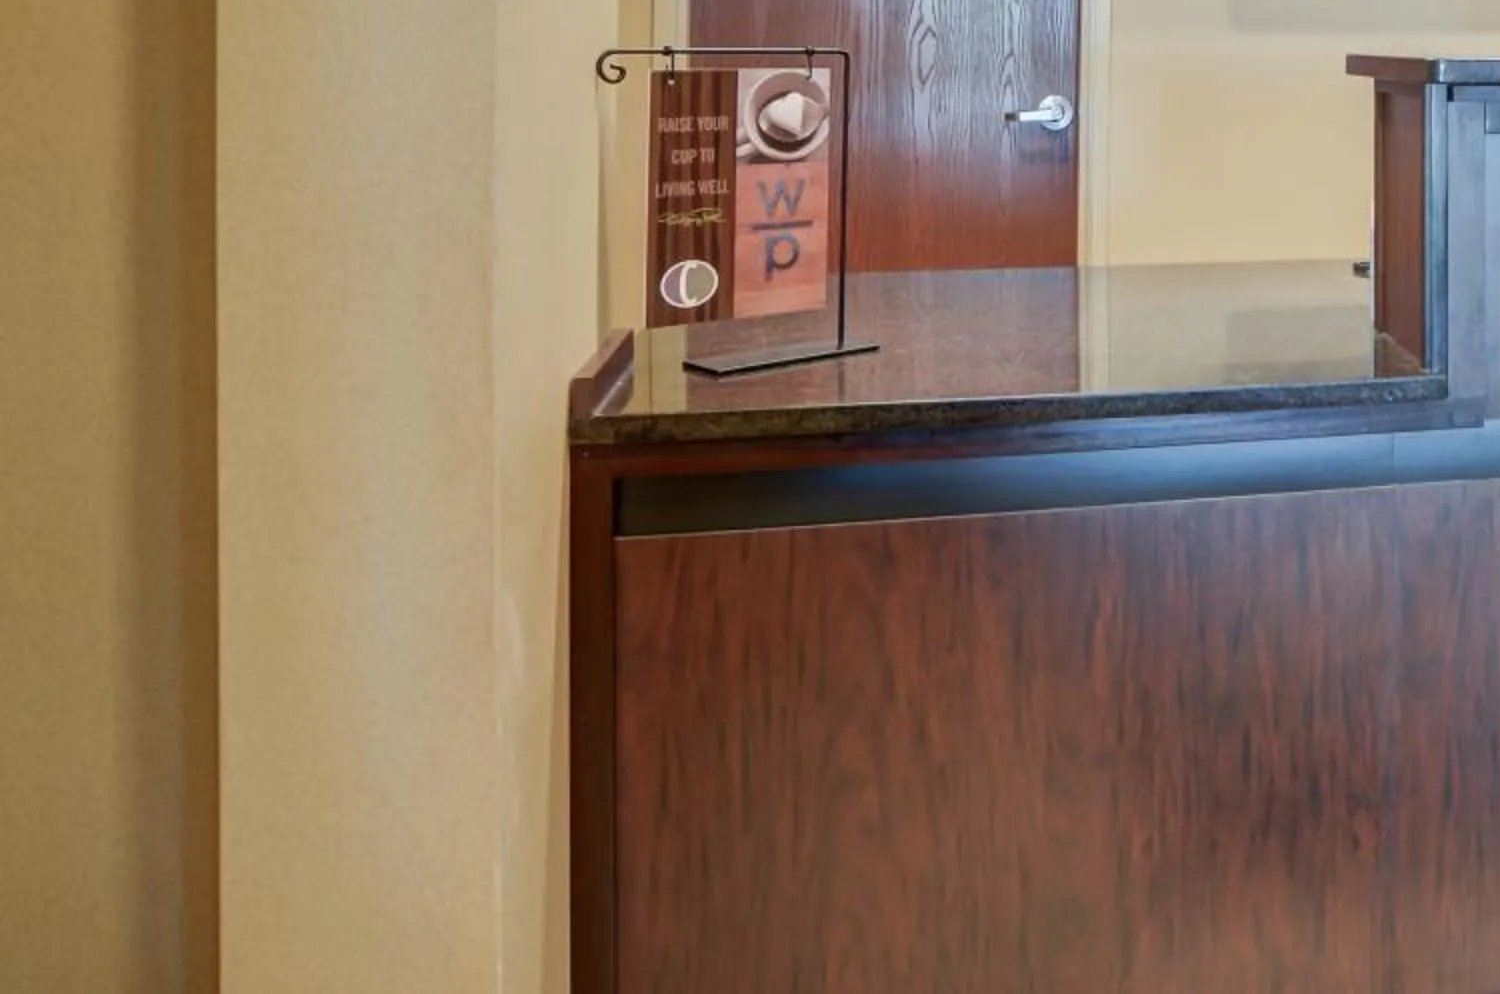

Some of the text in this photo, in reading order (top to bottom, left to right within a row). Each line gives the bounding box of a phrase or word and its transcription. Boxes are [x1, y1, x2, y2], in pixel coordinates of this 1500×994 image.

[658, 115, 729, 133] RAISE YOUR
[671, 146, 715, 165] CUP TO
[656, 178, 730, 199] LIVING WELL
